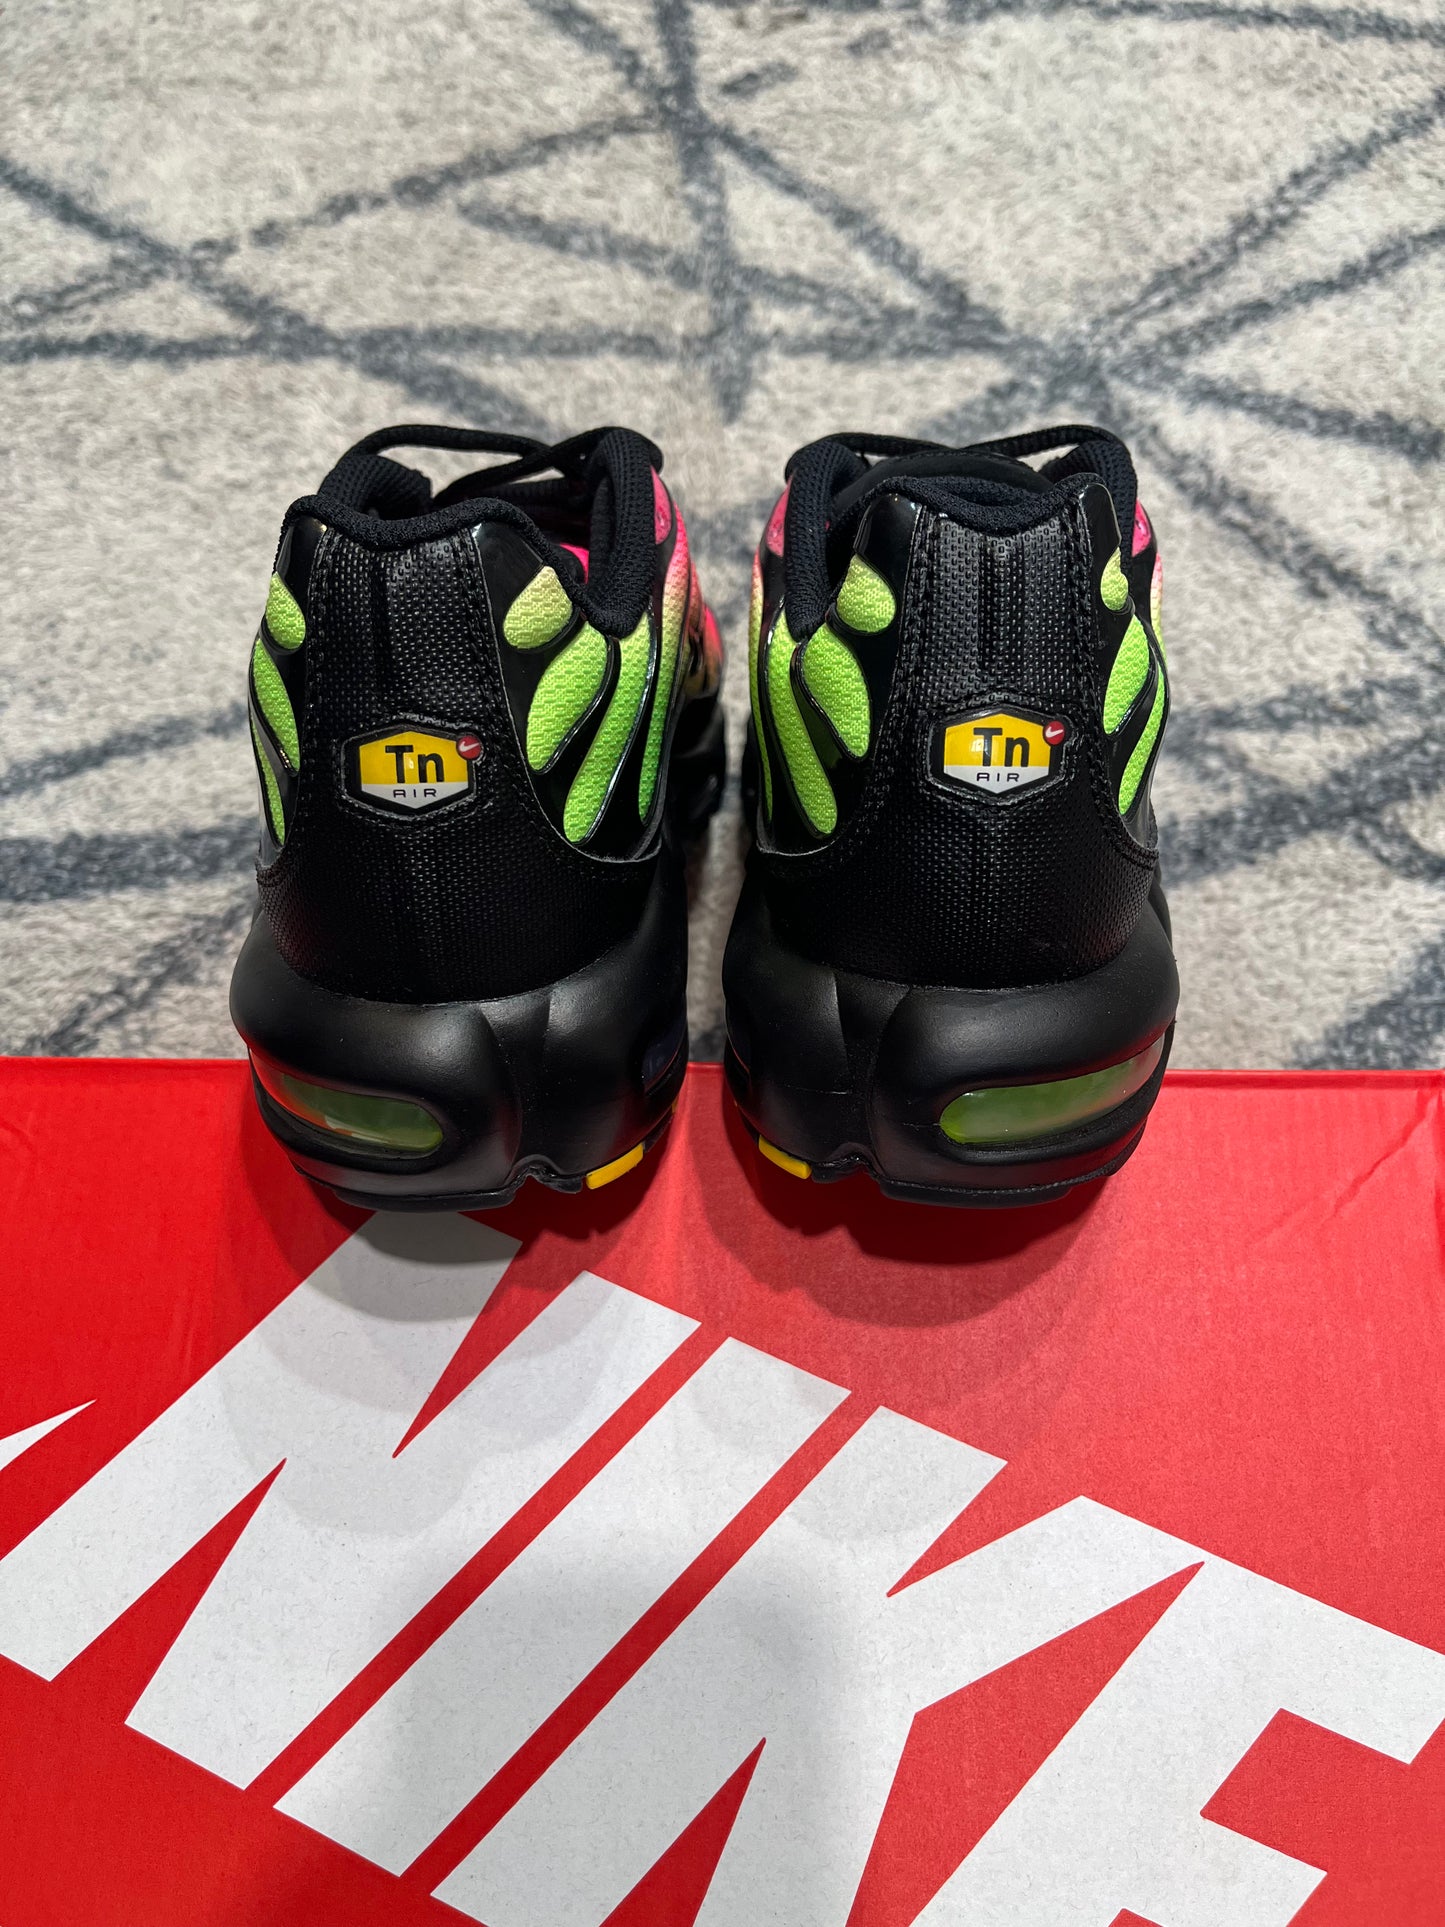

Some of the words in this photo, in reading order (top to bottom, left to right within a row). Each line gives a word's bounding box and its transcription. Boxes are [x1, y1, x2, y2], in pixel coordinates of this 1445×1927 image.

[385, 744, 445, 784] Tn
[973, 727, 1030, 767] Tn
[393, 788, 437, 798] AIR
[976, 772, 1020, 782] AIR
[0, 1209, 1445, 1927] NIKE
